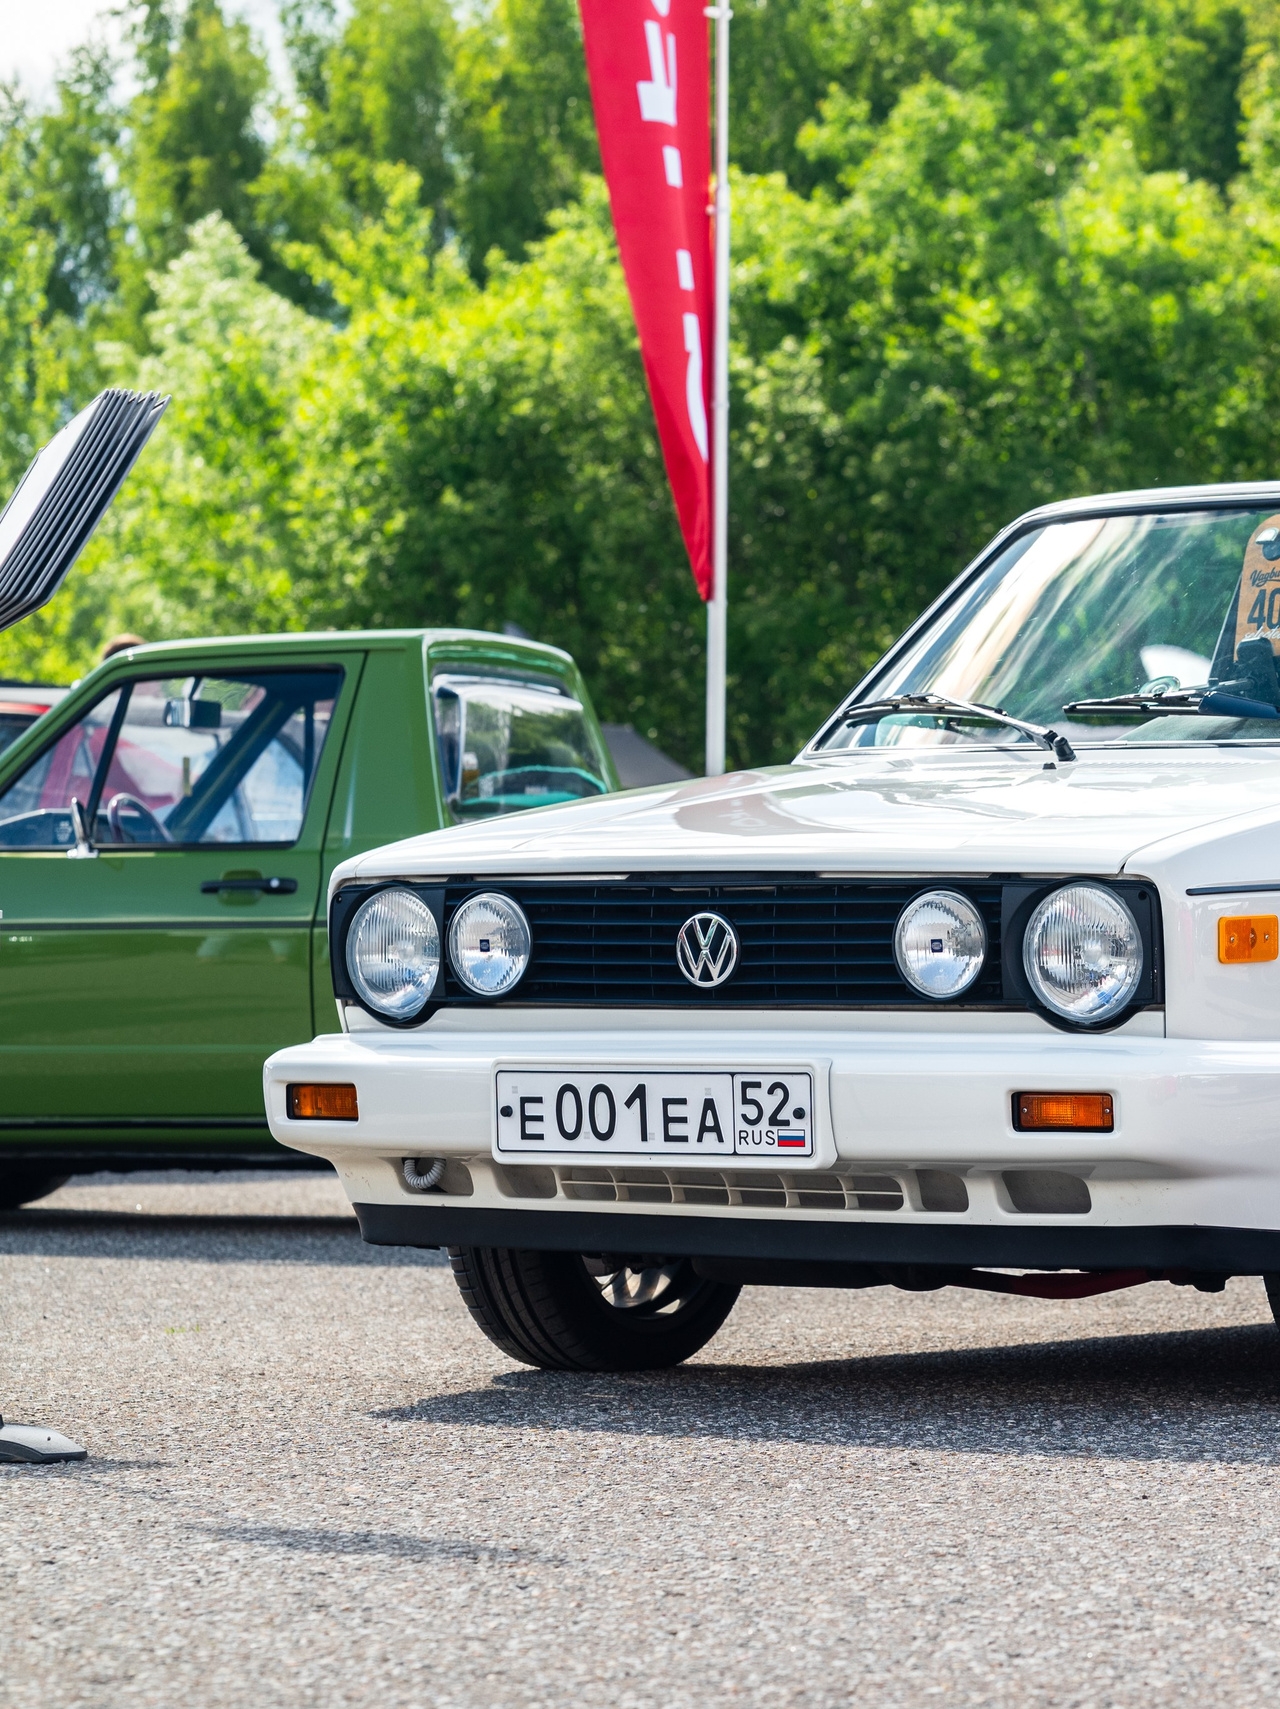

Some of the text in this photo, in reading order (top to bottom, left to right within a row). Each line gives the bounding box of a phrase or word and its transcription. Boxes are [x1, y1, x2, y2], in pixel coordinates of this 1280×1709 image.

[519, 1080, 791, 1143] E001EA 52
[738, 1130, 776, 1146] RUS
